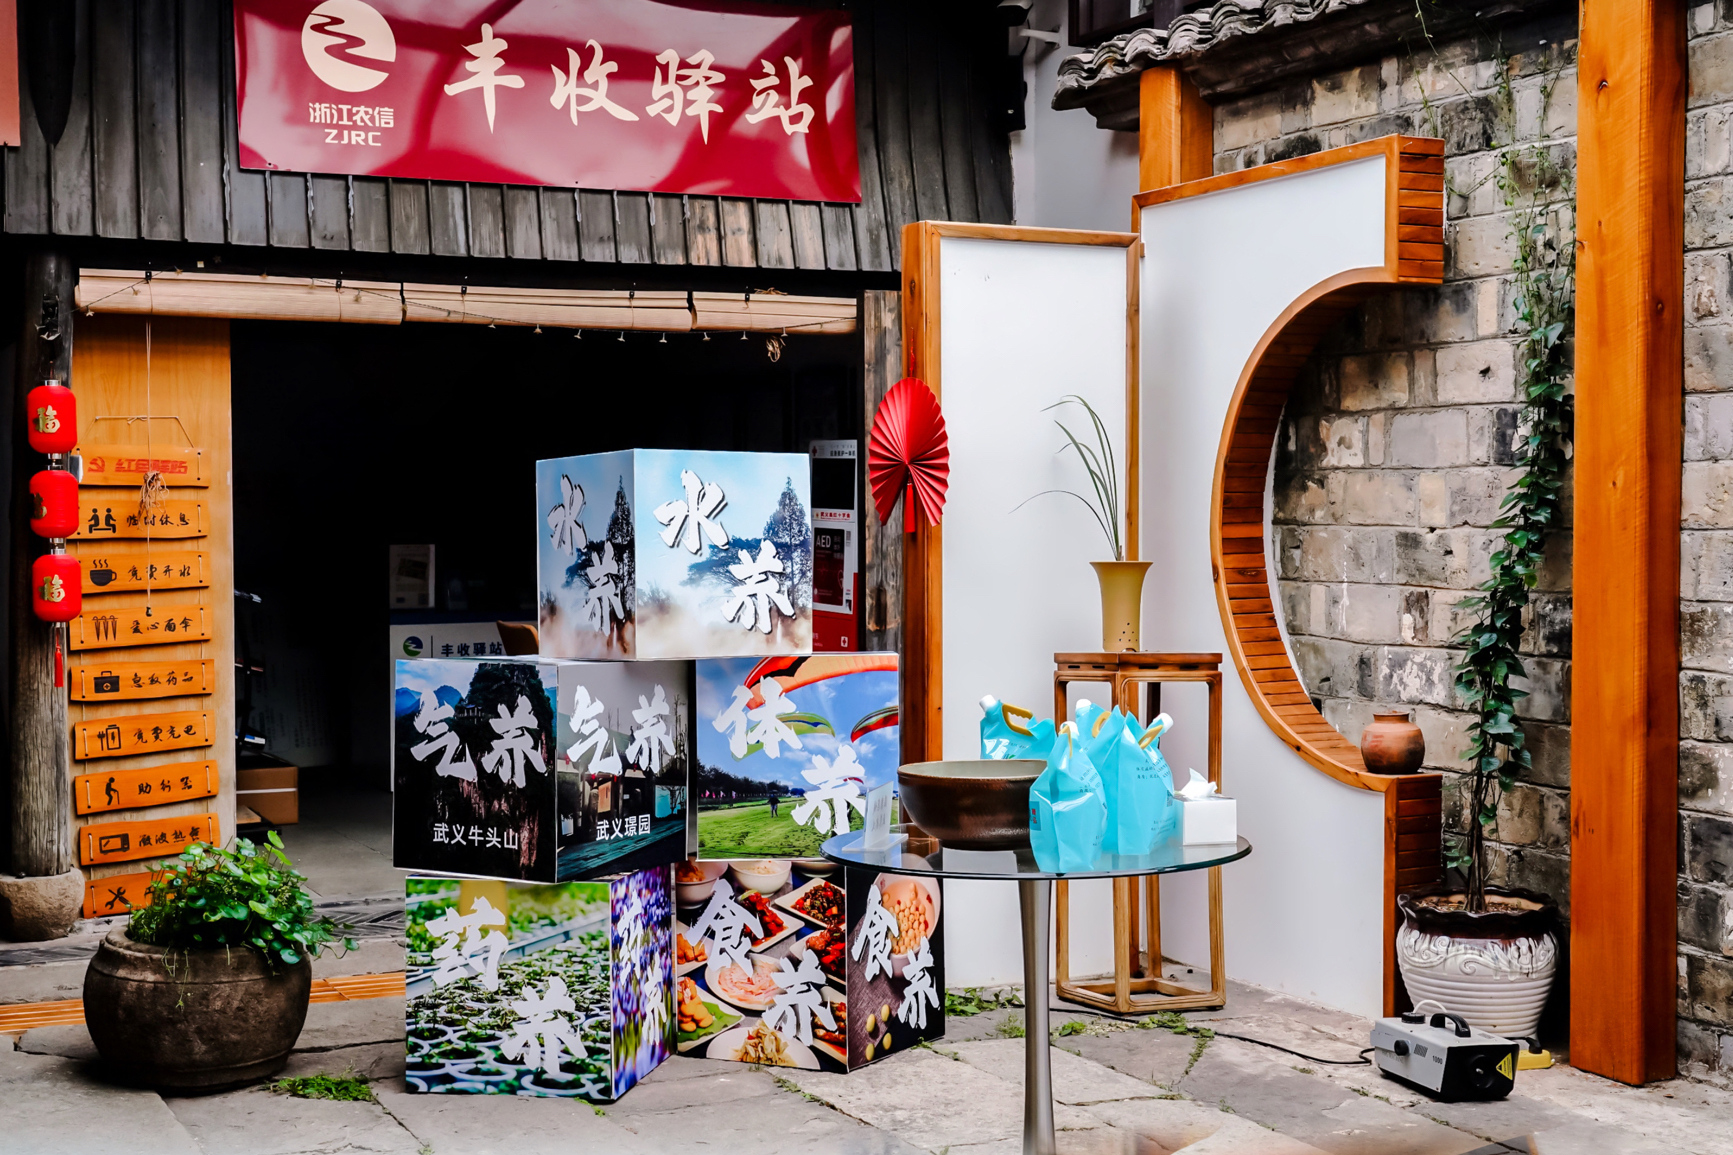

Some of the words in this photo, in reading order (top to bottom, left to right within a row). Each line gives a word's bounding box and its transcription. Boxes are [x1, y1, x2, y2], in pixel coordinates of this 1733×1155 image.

[444, 23, 814, 145] 丰收驿站
[309, 102, 394, 128] 浙江农信
[324, 129, 382, 146] ZJRC
[33, 405, 60, 433] 福
[816, 535, 831, 548] AED
[128, 564, 191, 582] 免费开水
[38, 574, 65, 603] 福
[130, 616, 193, 635] 爱心雨伞
[441, 641, 502, 658] 丰收驿站
[131, 670, 194, 689] 急救药品
[133, 725, 197, 746] 免费充电
[138, 776, 193, 795] 助行器
[433, 822, 519, 850] 武义牛头山
[595, 812, 651, 841] 武义璟园
